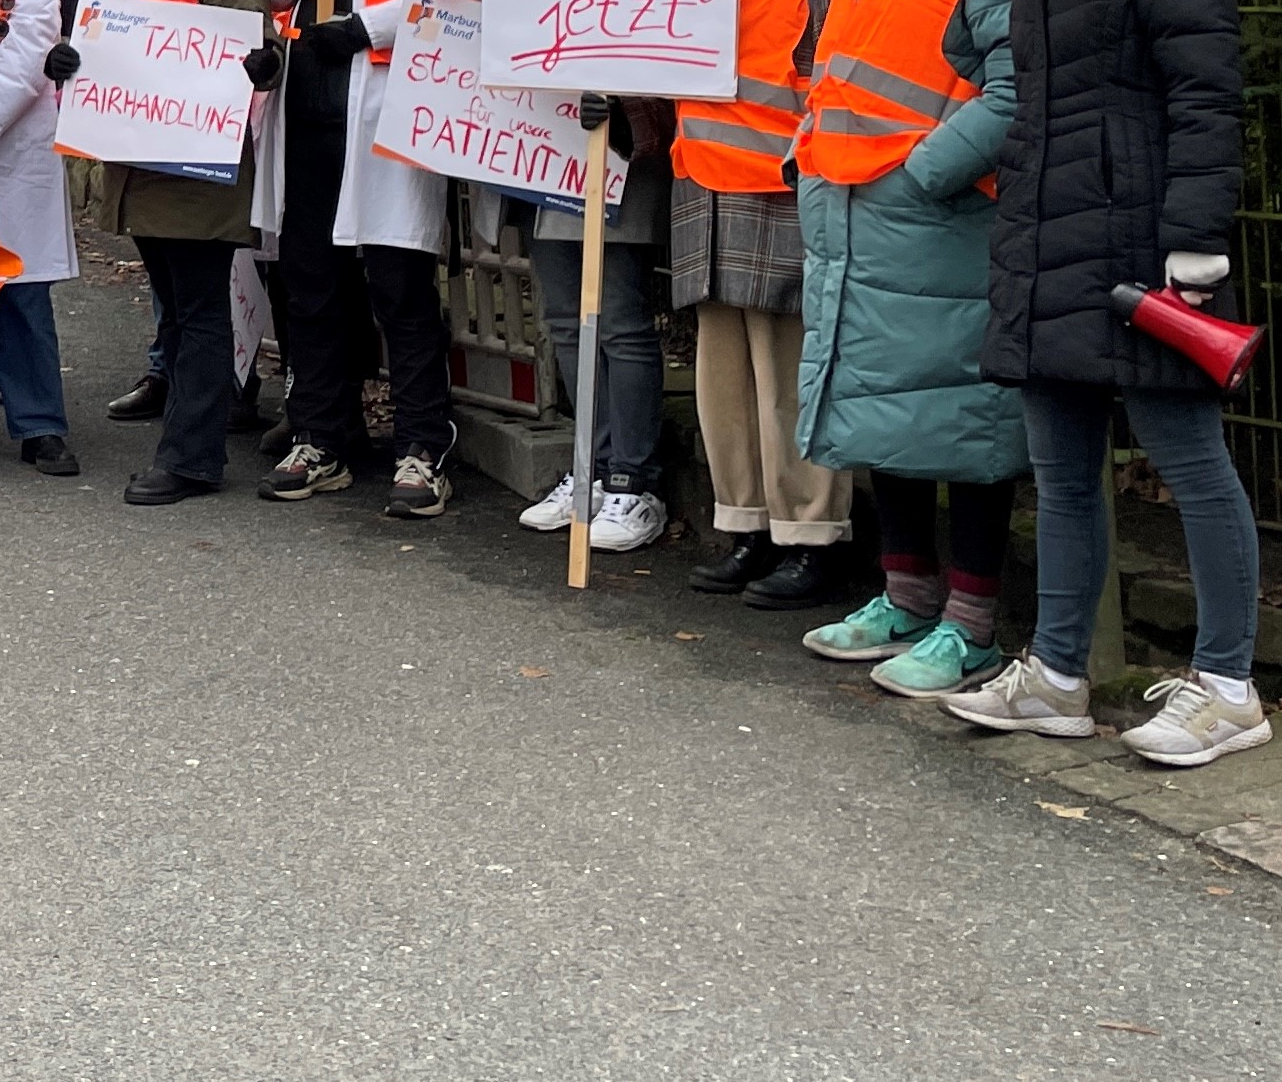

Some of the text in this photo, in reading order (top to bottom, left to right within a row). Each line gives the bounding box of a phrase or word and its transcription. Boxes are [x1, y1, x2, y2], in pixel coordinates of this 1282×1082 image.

[101, 9, 151, 25] Marburger
[106, 22, 131, 34] Bund
[443, 25, 474, 40] Bund
[143, 24, 247, 71] TARIF-
[72, 78, 245, 142] FAIRHANDLUNG
[464, 95, 496, 124] für
